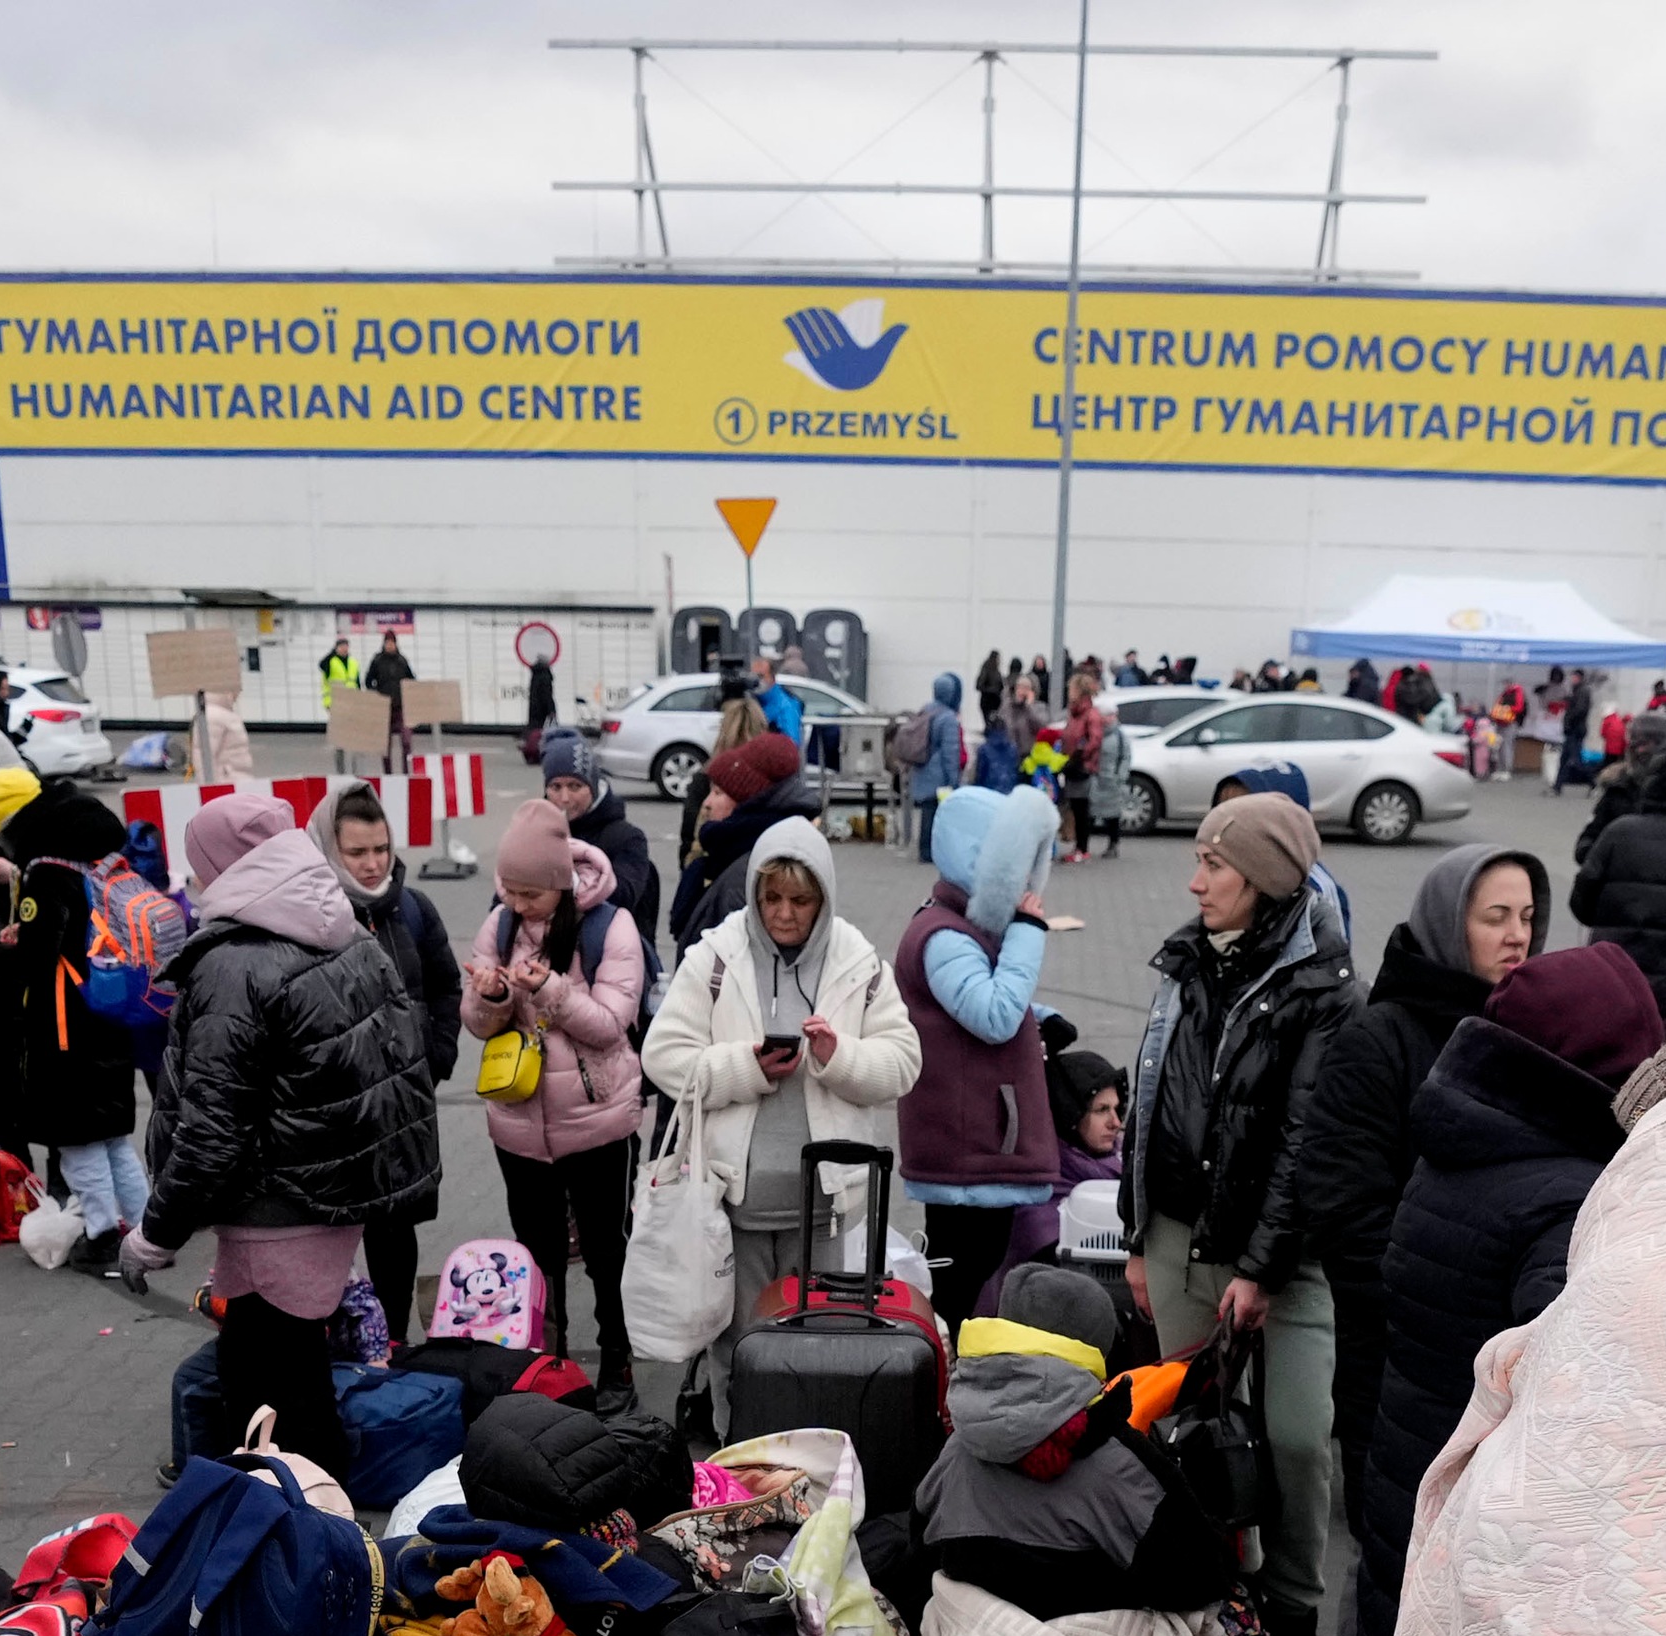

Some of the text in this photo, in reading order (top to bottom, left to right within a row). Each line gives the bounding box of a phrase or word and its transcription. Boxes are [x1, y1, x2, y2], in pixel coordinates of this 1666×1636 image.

[352, 318, 641, 362] ДОПОМОГИ
[1275, 333, 1489, 375] POMOCY
[10, 383, 641, 421] HUMANITARIAN AID CENTRE
[768, 404, 958, 440] PRZEMYŚL
[1033, 395, 1178, 436] ЦЕНТР
[1193, 397, 1595, 445] ГУМАНИТАРНОЙ
